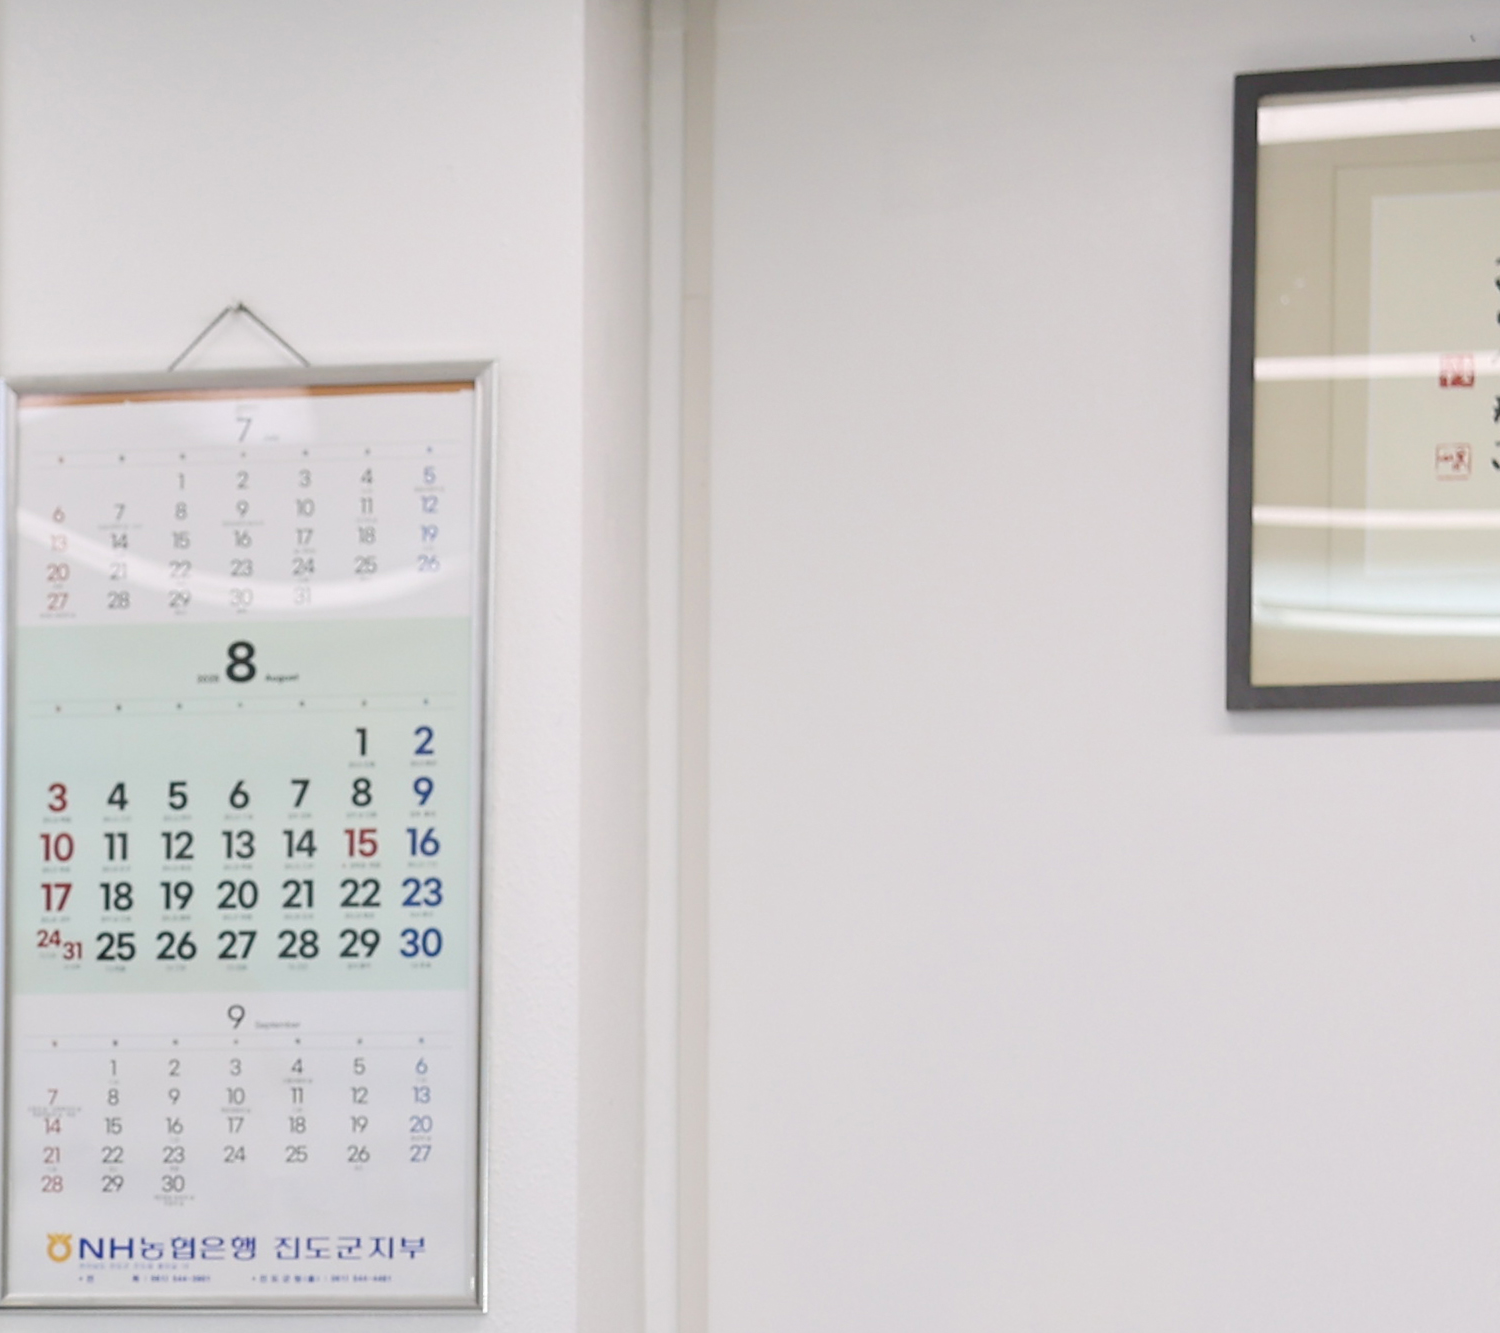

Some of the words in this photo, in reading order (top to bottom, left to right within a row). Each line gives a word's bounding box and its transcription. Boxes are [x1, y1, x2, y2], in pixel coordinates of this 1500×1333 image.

[236, 416, 252, 442] 7
[178, 472, 185, 490] 1
[237, 471, 249, 490] 2
[299, 469, 311, 488] 3
[361, 468, 373, 485] 4
[423, 466, 436, 485] 5
[52, 506, 65, 524] 6
[115, 503, 126, 521] 7
[175, 502, 188, 520] 8
[236, 500, 249, 518] 9
[296, 498, 315, 517] 10
[360, 497, 373, 514] 11
[421, 495, 438, 514] 12
[111, 533, 128, 549] 14
[172, 531, 190, 550] 15
[234, 530, 252, 548] 16
[296, 528, 314, 545] 17
[358, 526, 376, 544] 18
[421, 525, 438, 541] 19
[47, 563, 70, 582] 20
[231, 558, 253, 577] 23
[293, 558, 315, 576] 24
[355, 556, 377, 574] 25
[47, 592, 69, 611] 27
[107, 591, 130, 609] 28
[169, 591, 190, 609] 29
[226, 641, 257, 683] 8
[356, 728, 366, 756] 1
[415, 726, 434, 755] 2
[48, 783, 67, 812] 3
[107, 782, 128, 810] 4
[169, 781, 187, 810] 5
[229, 780, 249, 809] 6
[291, 779, 310, 807] 7
[352, 777, 372, 807] 8
[413, 777, 434, 805] 9
[40, 833, 74, 862] 10
[104, 832, 127, 861] 11
[161, 831, 194, 860] 12
[222, 830, 255, 859] 13
[283, 829, 317, 858] 14
[344, 828, 378, 857] 15
[407, 828, 440, 856] 16
[41, 883, 72, 911] 17
[100, 882, 133, 911] 18
[160, 881, 193, 910] 19
[218, 880, 258, 909] 20
[283, 880, 313, 908] 21
[340, 878, 380, 907] 22
[402, 877, 442, 907] 23
[38, 930, 61, 947] 24
[64, 942, 82, 960] 31
[97, 932, 136, 961] 25
[157, 931, 197, 960] 26
[218, 930, 257, 959] 27
[278, 929, 319, 959] 28
[340, 929, 380, 958] 29
[400, 928, 442, 958] 30
[227, 1004, 245, 1029] 9
[111, 1059, 116, 1076] 1
[169, 1058, 180, 1077] 2
[230, 1058, 242, 1076] 3
[291, 1058, 303, 1074] 4
[354, 1057, 366, 1075] 5
[415, 1058, 428, 1075] 6
[47, 1089, 58, 1105] 7
[108, 1088, 119, 1106] 8
[168, 1088, 180, 1105] 9
[227, 1087, 245, 1105] 10
[291, 1087, 303, 1103] 11
[351, 1086, 368, 1104] 12
[413, 1086, 431, 1104] 13
[44, 1116, 61, 1134] 14
[105, 1117, 122, 1135] 15
[166, 1117, 183, 1135] 16
[228, 1116, 244, 1133] 17
[289, 1116, 306, 1134] 18
[351, 1116, 368, 1133] 19
[410, 1115, 433, 1133] 20
[43, 1146, 60, 1164] 21
[102, 1146, 123, 1164] 22
[163, 1146, 185, 1164] 23
[224, 1146, 245, 1163] 24
[285, 1145, 308, 1163] 25
[348, 1145, 370, 1163] 26
[410, 1145, 432, 1162] 27
[41, 1175, 63, 1193] 28
[102, 1175, 124, 1192] 29
[162, 1175, 185, 1193] 30
[78, 1236, 257, 1261] NH농협은행
[274, 1236, 427, 1261] 진도군지부
